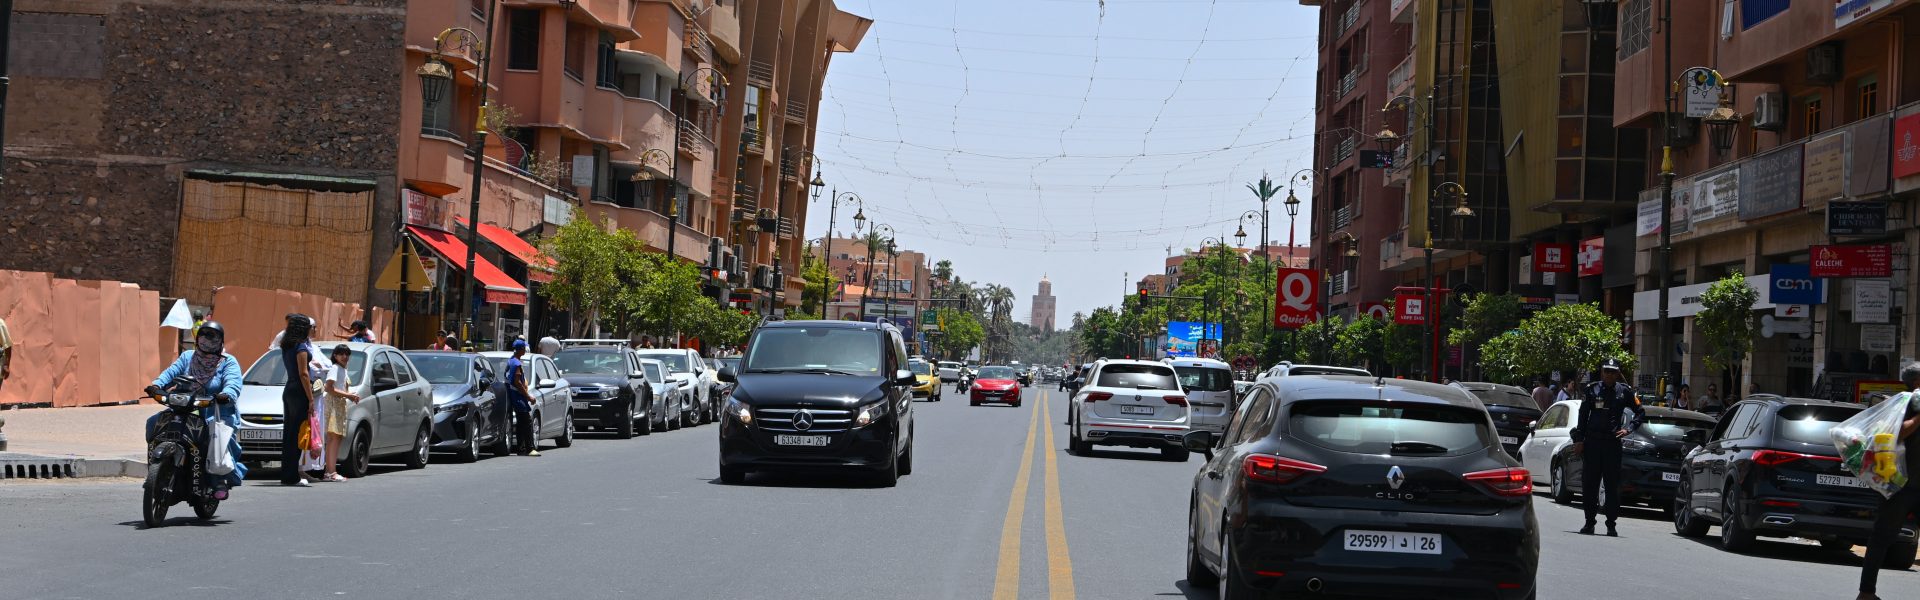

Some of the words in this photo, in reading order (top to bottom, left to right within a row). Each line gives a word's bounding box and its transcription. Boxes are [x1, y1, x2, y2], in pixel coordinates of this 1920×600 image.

[1781, 151, 1799, 168] CAR
[1281, 272, 1312, 311] Q
[1280, 313, 1310, 324] Quick
[243, 430, 264, 439] 15012
[815, 436, 824, 445] 26
[1819, 475, 1841, 485] 52729
[1375, 492, 1414, 500] CLIO
[1349, 534, 1388, 548] 29599
[1420, 537, 1436, 551] 26
